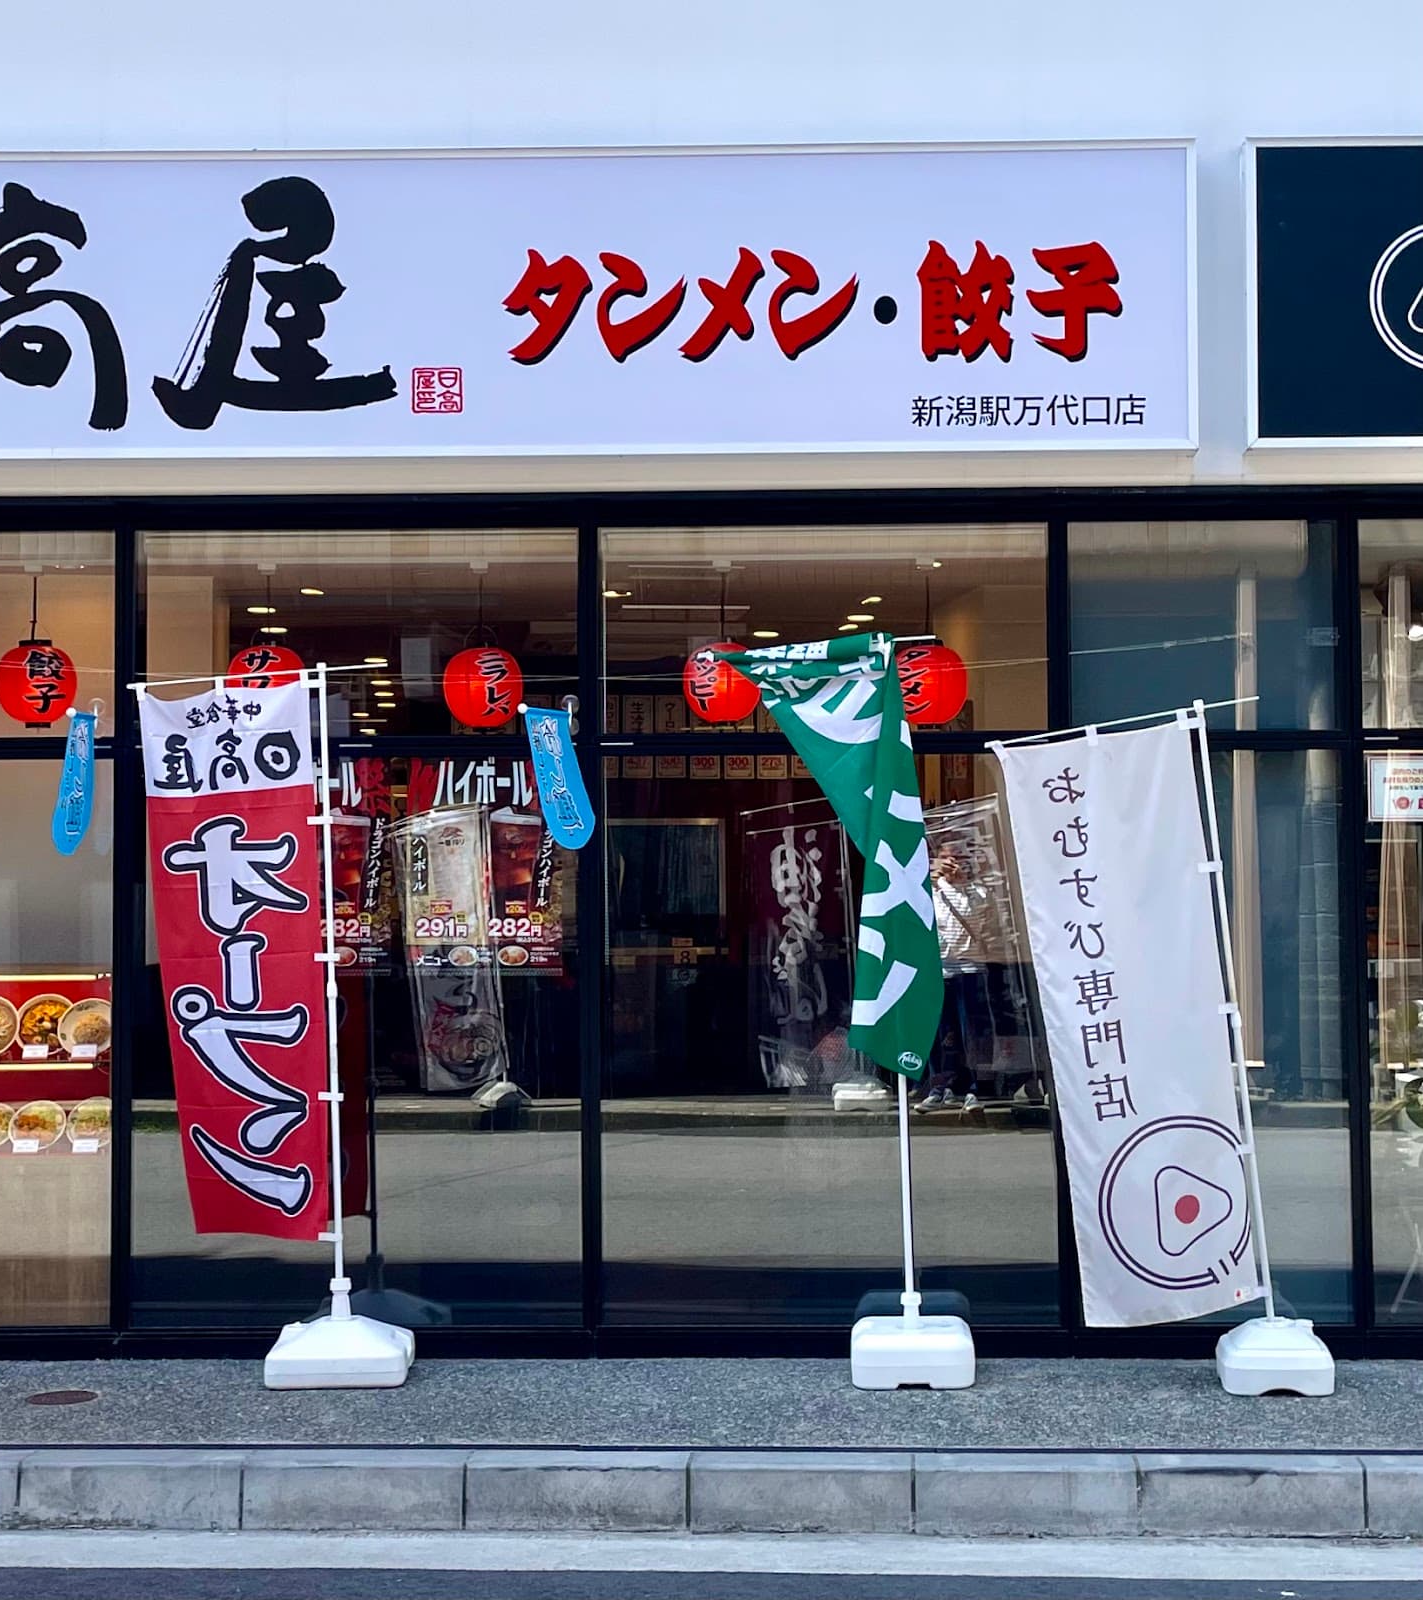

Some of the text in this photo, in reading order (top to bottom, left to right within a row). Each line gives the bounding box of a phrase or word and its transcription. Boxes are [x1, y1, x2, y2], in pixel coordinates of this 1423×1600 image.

[502, 241, 1124, 366] タンメン・餃子
[911, 394, 1147, 427] 新潟駅万代口店
[24, 650, 66, 713] 餃子
[690, 649, 721, 712] ッピー
[433, 756, 533, 807] ハイボール
[415, 917, 468, 938] 291円
[488, 917, 542, 937] 282円
